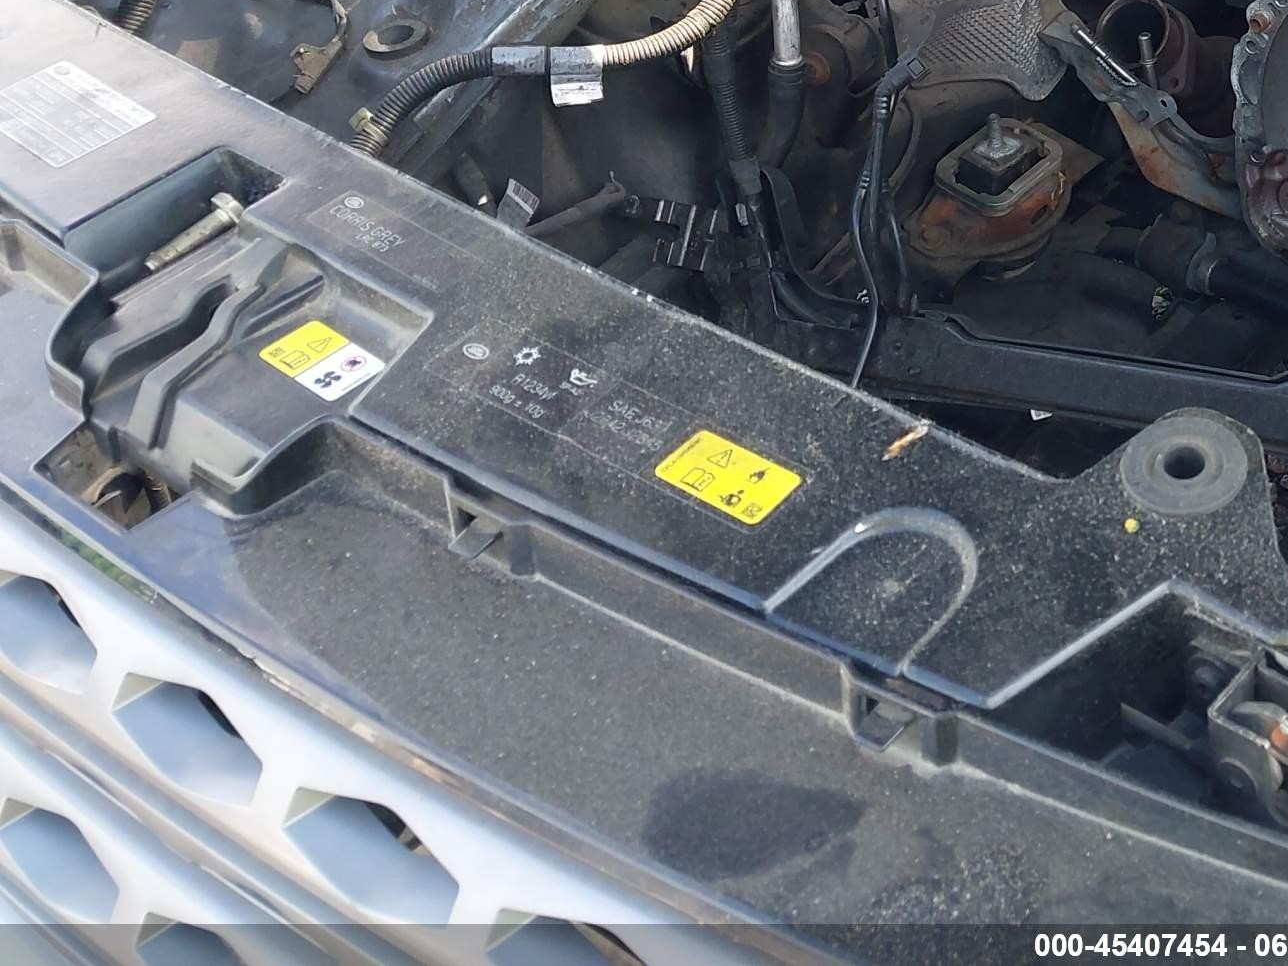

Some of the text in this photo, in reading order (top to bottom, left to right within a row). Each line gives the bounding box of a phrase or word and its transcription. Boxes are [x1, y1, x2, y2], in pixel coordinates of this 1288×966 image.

[330, 205, 406, 248] CORRIS GREY
[489, 385, 515, 404] 900g
[526, 403, 544, 419] 10g
[608, 401, 639, 419] SAE
